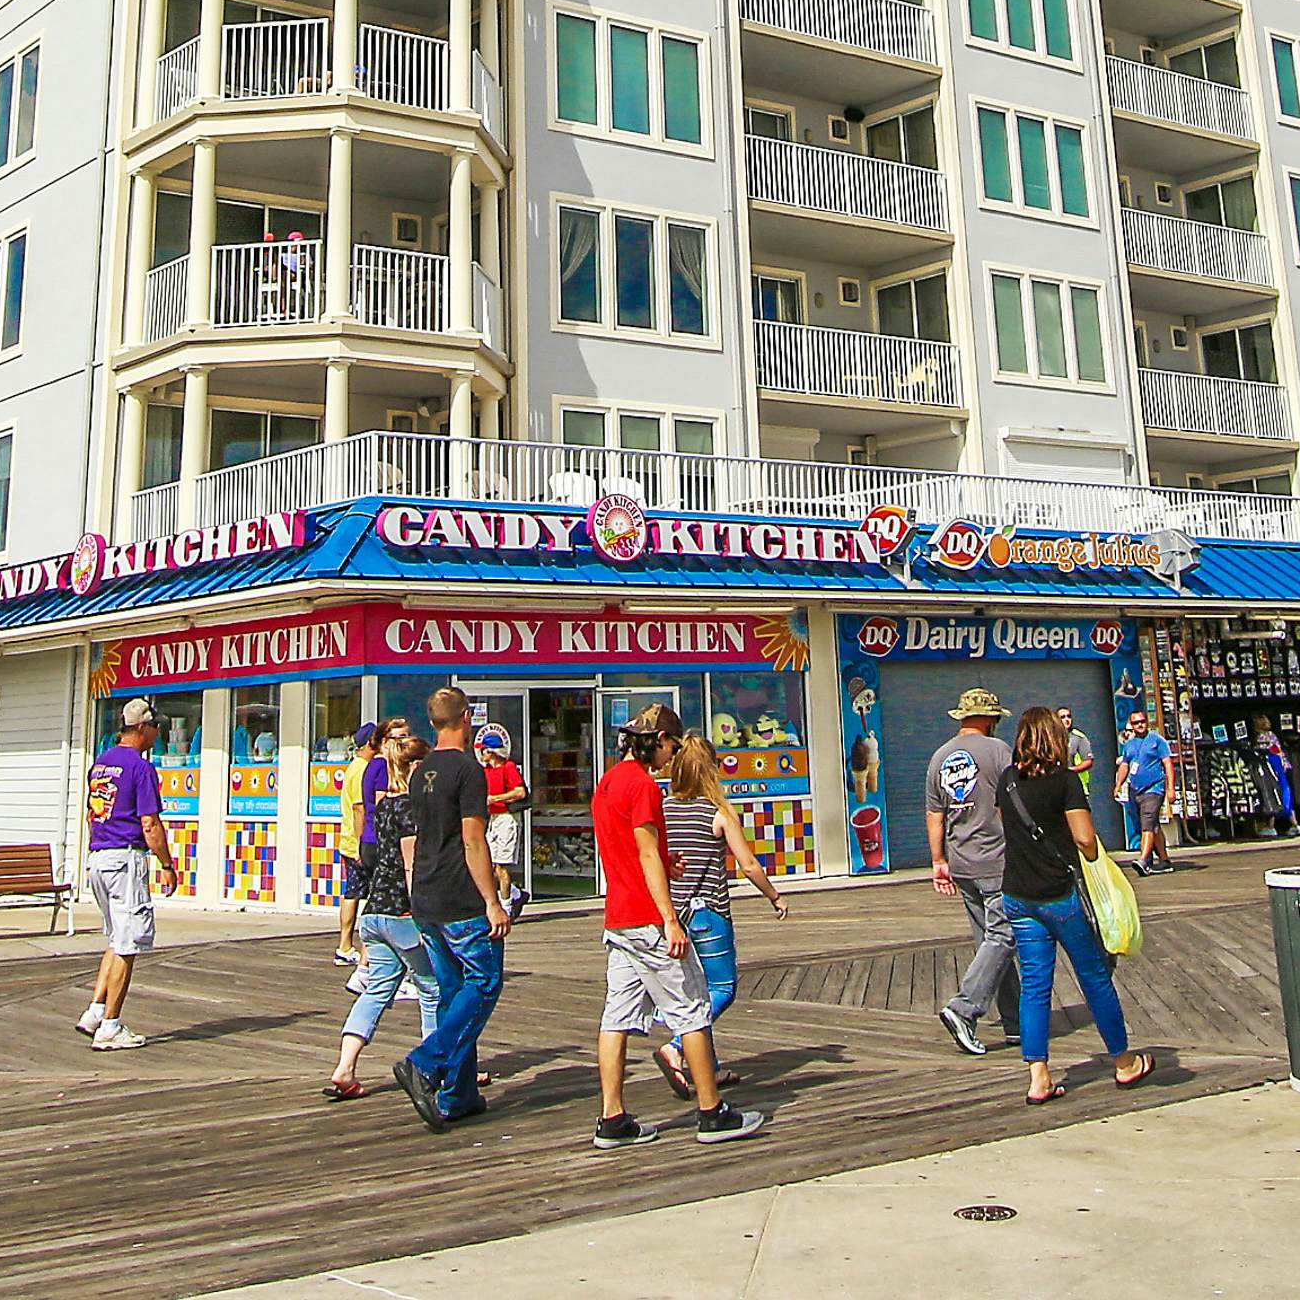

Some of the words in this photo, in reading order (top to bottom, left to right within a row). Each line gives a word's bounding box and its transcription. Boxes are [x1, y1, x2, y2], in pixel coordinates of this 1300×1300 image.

[101, 509, 306, 582] KITCHEN
[381, 507, 582, 551] CANDY
[655, 519, 882, 564] KITCHEN
[867, 515, 901, 545] DQ
[945, 530, 980, 557] DQ
[988, 528, 1087, 573] Orange
[1087, 534, 1161, 568] Julius
[130, 638, 213, 680] CANDY
[220, 620, 349, 670] KITCHEN
[385, 619, 543, 654] CANDY
[558, 621, 746, 653] KITCHEN
[864, 625, 893, 648] DQ
[905, 617, 986, 657] Dairy
[993, 618, 1081, 654] Queen
[1095, 626, 1121, 646] DQ
